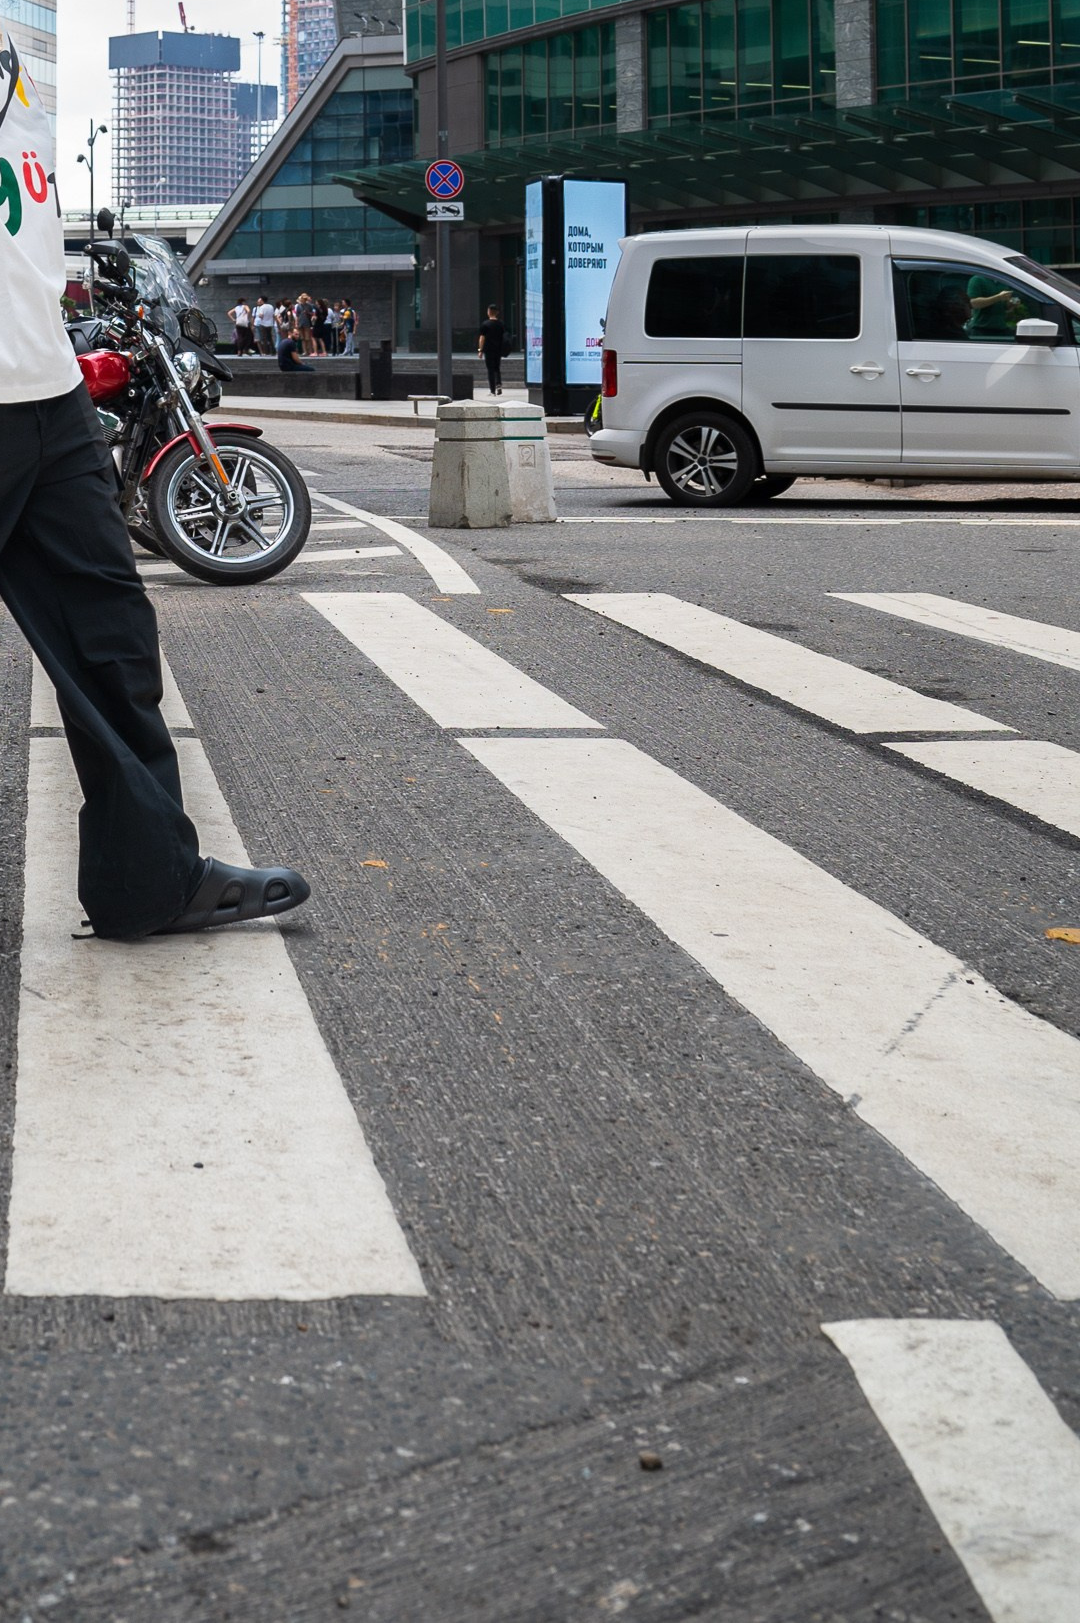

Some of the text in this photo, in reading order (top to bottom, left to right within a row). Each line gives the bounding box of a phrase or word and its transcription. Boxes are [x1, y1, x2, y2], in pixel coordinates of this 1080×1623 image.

[568, 226, 591, 238] ДОМА,
[568, 242, 604, 253] КОТОРЫМ
[568, 258, 607, 269] ДОВЕРЯЮТ
